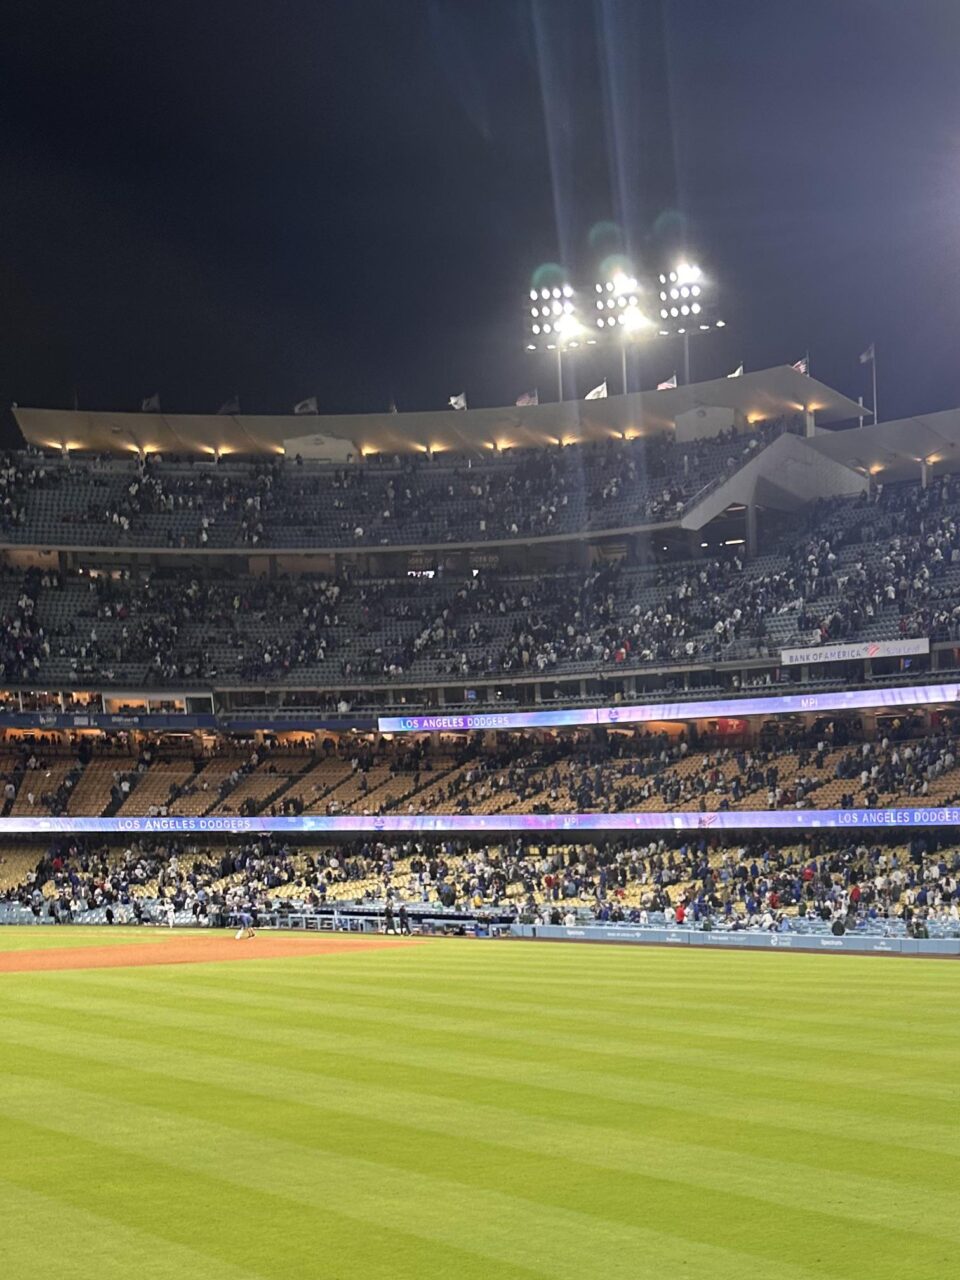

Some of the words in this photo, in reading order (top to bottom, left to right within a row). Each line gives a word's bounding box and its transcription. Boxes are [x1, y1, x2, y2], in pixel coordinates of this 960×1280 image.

[789, 654, 811, 663] BANK
[812, 652, 823, 661] OF
[824, 649, 862, 660] AMERICA
[800, 698, 818, 708] MPI
[400, 719, 419, 729] LOS
[422, 718, 464, 729] ANGELES
[467, 716, 510, 727] DODGERS
[118, 819, 141, 829] LOS
[145, 819, 196, 829] ANGELES
[200, 819, 250, 829] DODGERS
[838, 812, 858, 824] LOS
[862, 811, 910, 824] ANGELES
